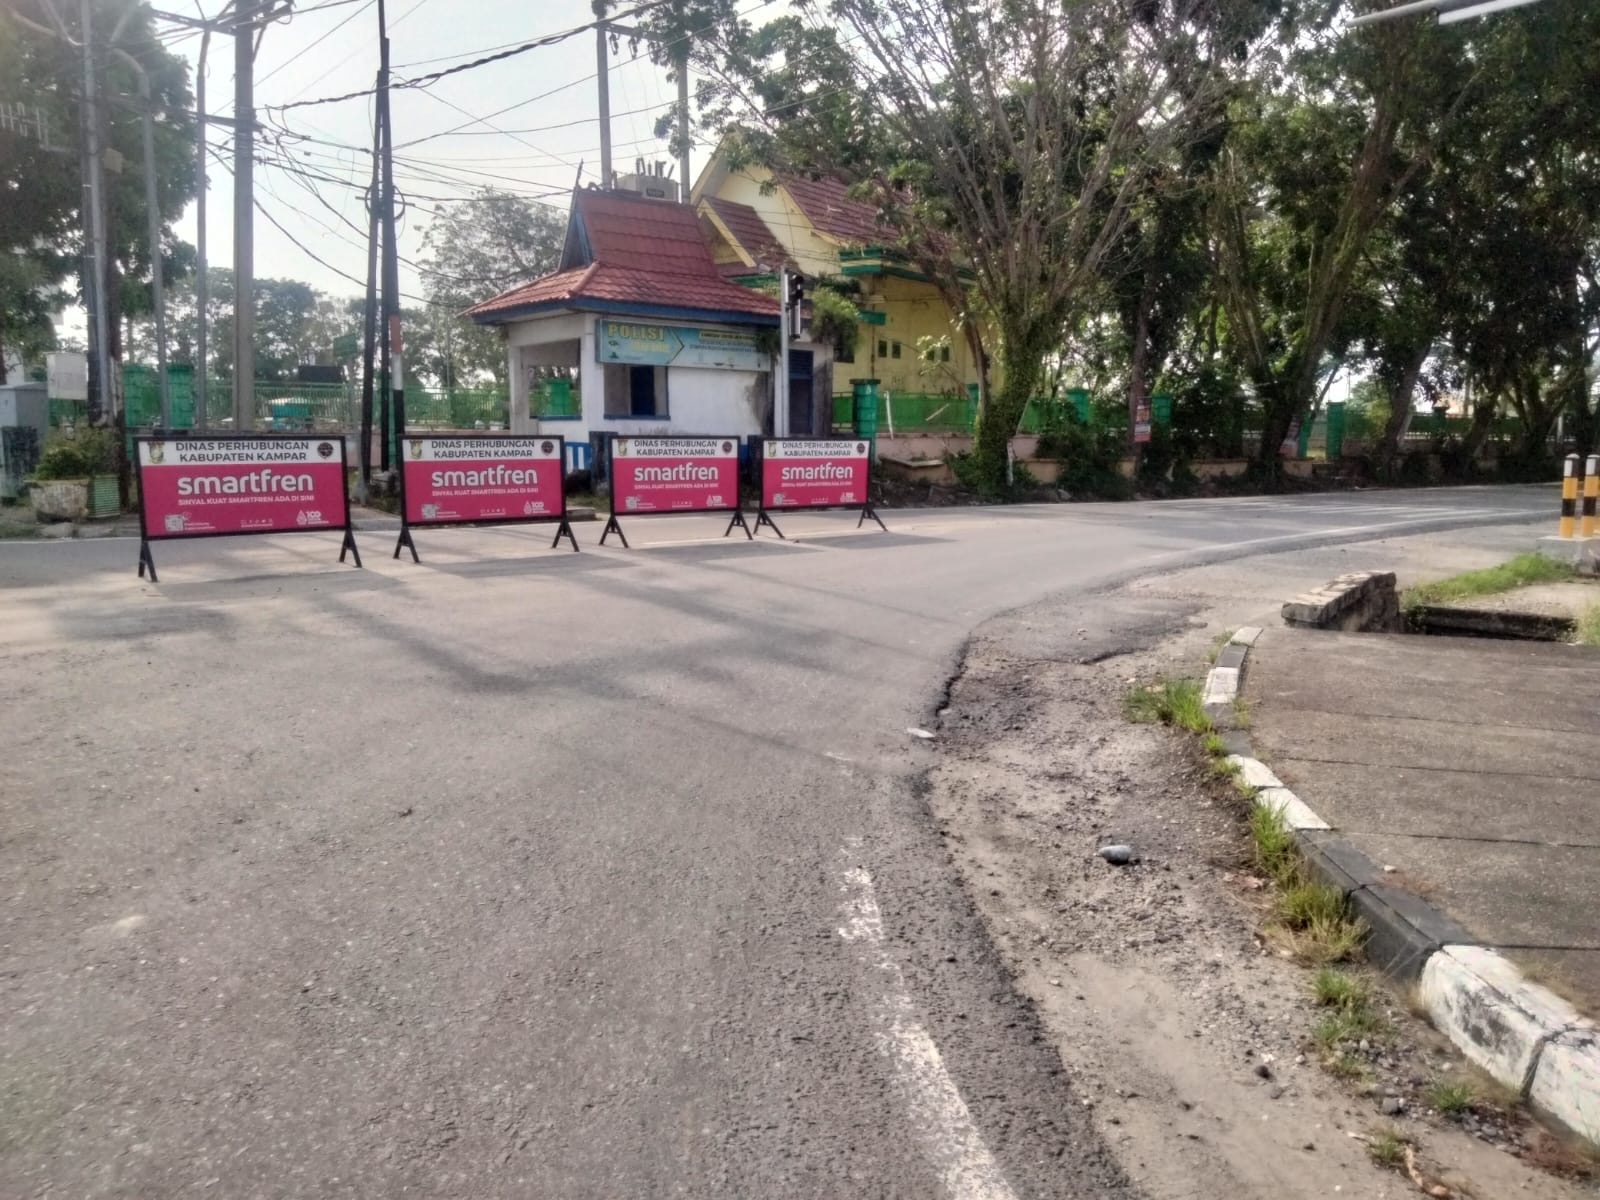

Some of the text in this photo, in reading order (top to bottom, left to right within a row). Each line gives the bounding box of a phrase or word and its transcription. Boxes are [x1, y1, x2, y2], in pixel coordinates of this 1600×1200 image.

[608, 324, 664, 341] POLISI
[176, 441, 309, 451] DINAS PERHUBUNGAN
[431, 440, 535, 449] DINAS PERHUBUNGAN
[179, 452, 307, 463] KABUPATEN KAMPAR
[434, 449, 532, 459] KABUPATEN KAMPAR
[684, 448, 715, 456] KAMPAR
[431, 465, 538, 487] smartfren
[634, 462, 718, 481] smartfren
[781, 462, 853, 480] smartfren
[177, 469, 313, 495] smartfren
[178, 498, 206, 506] SINYAL
